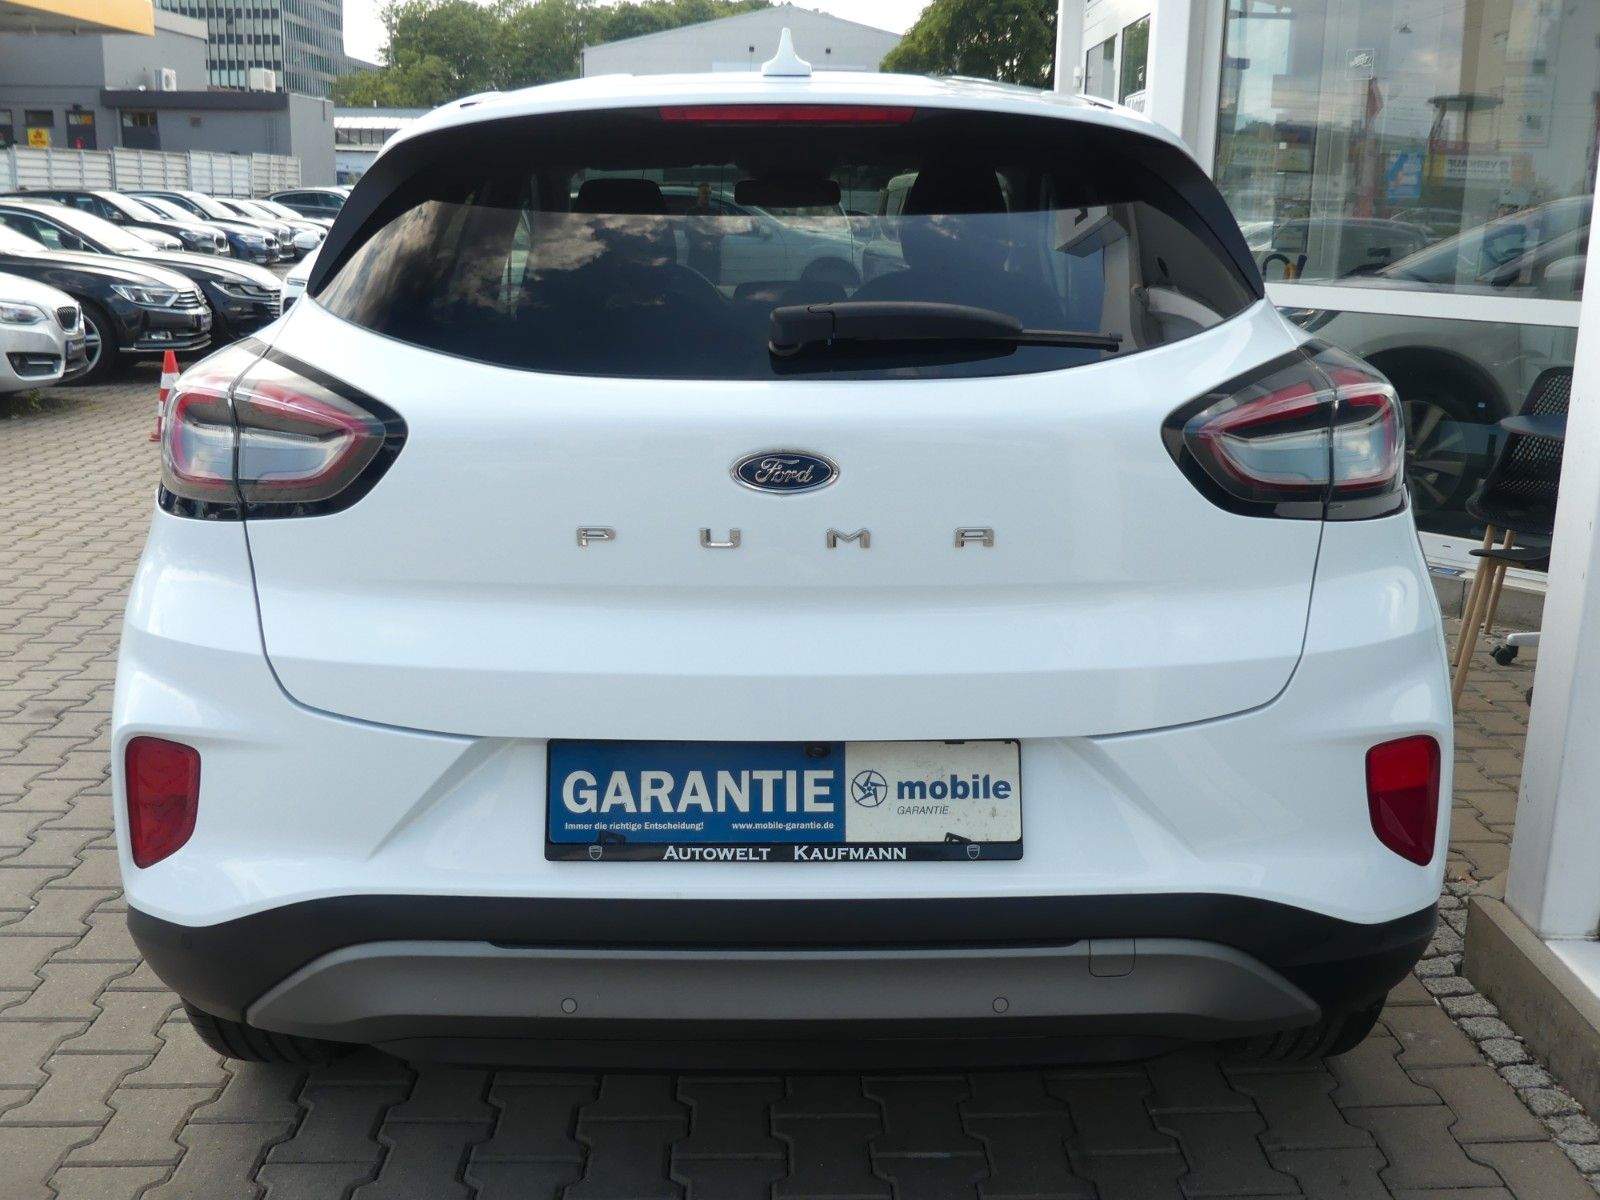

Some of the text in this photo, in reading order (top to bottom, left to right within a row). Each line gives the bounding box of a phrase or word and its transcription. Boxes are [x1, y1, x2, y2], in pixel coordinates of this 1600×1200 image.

[755, 457, 814, 485] Ford
[576, 525, 995, 549] PUMA
[562, 769, 835, 814] GARANTIE
[897, 774, 1012, 800] mobile
[897, 805, 950, 816] GARANTIE
[564, 821, 705, 832] Immer die richtige Entscheidung!
[731, 820, 835, 832] www.mobile-garantie.de
[662, 844, 907, 861] AUTOWELT KAUFMANN
